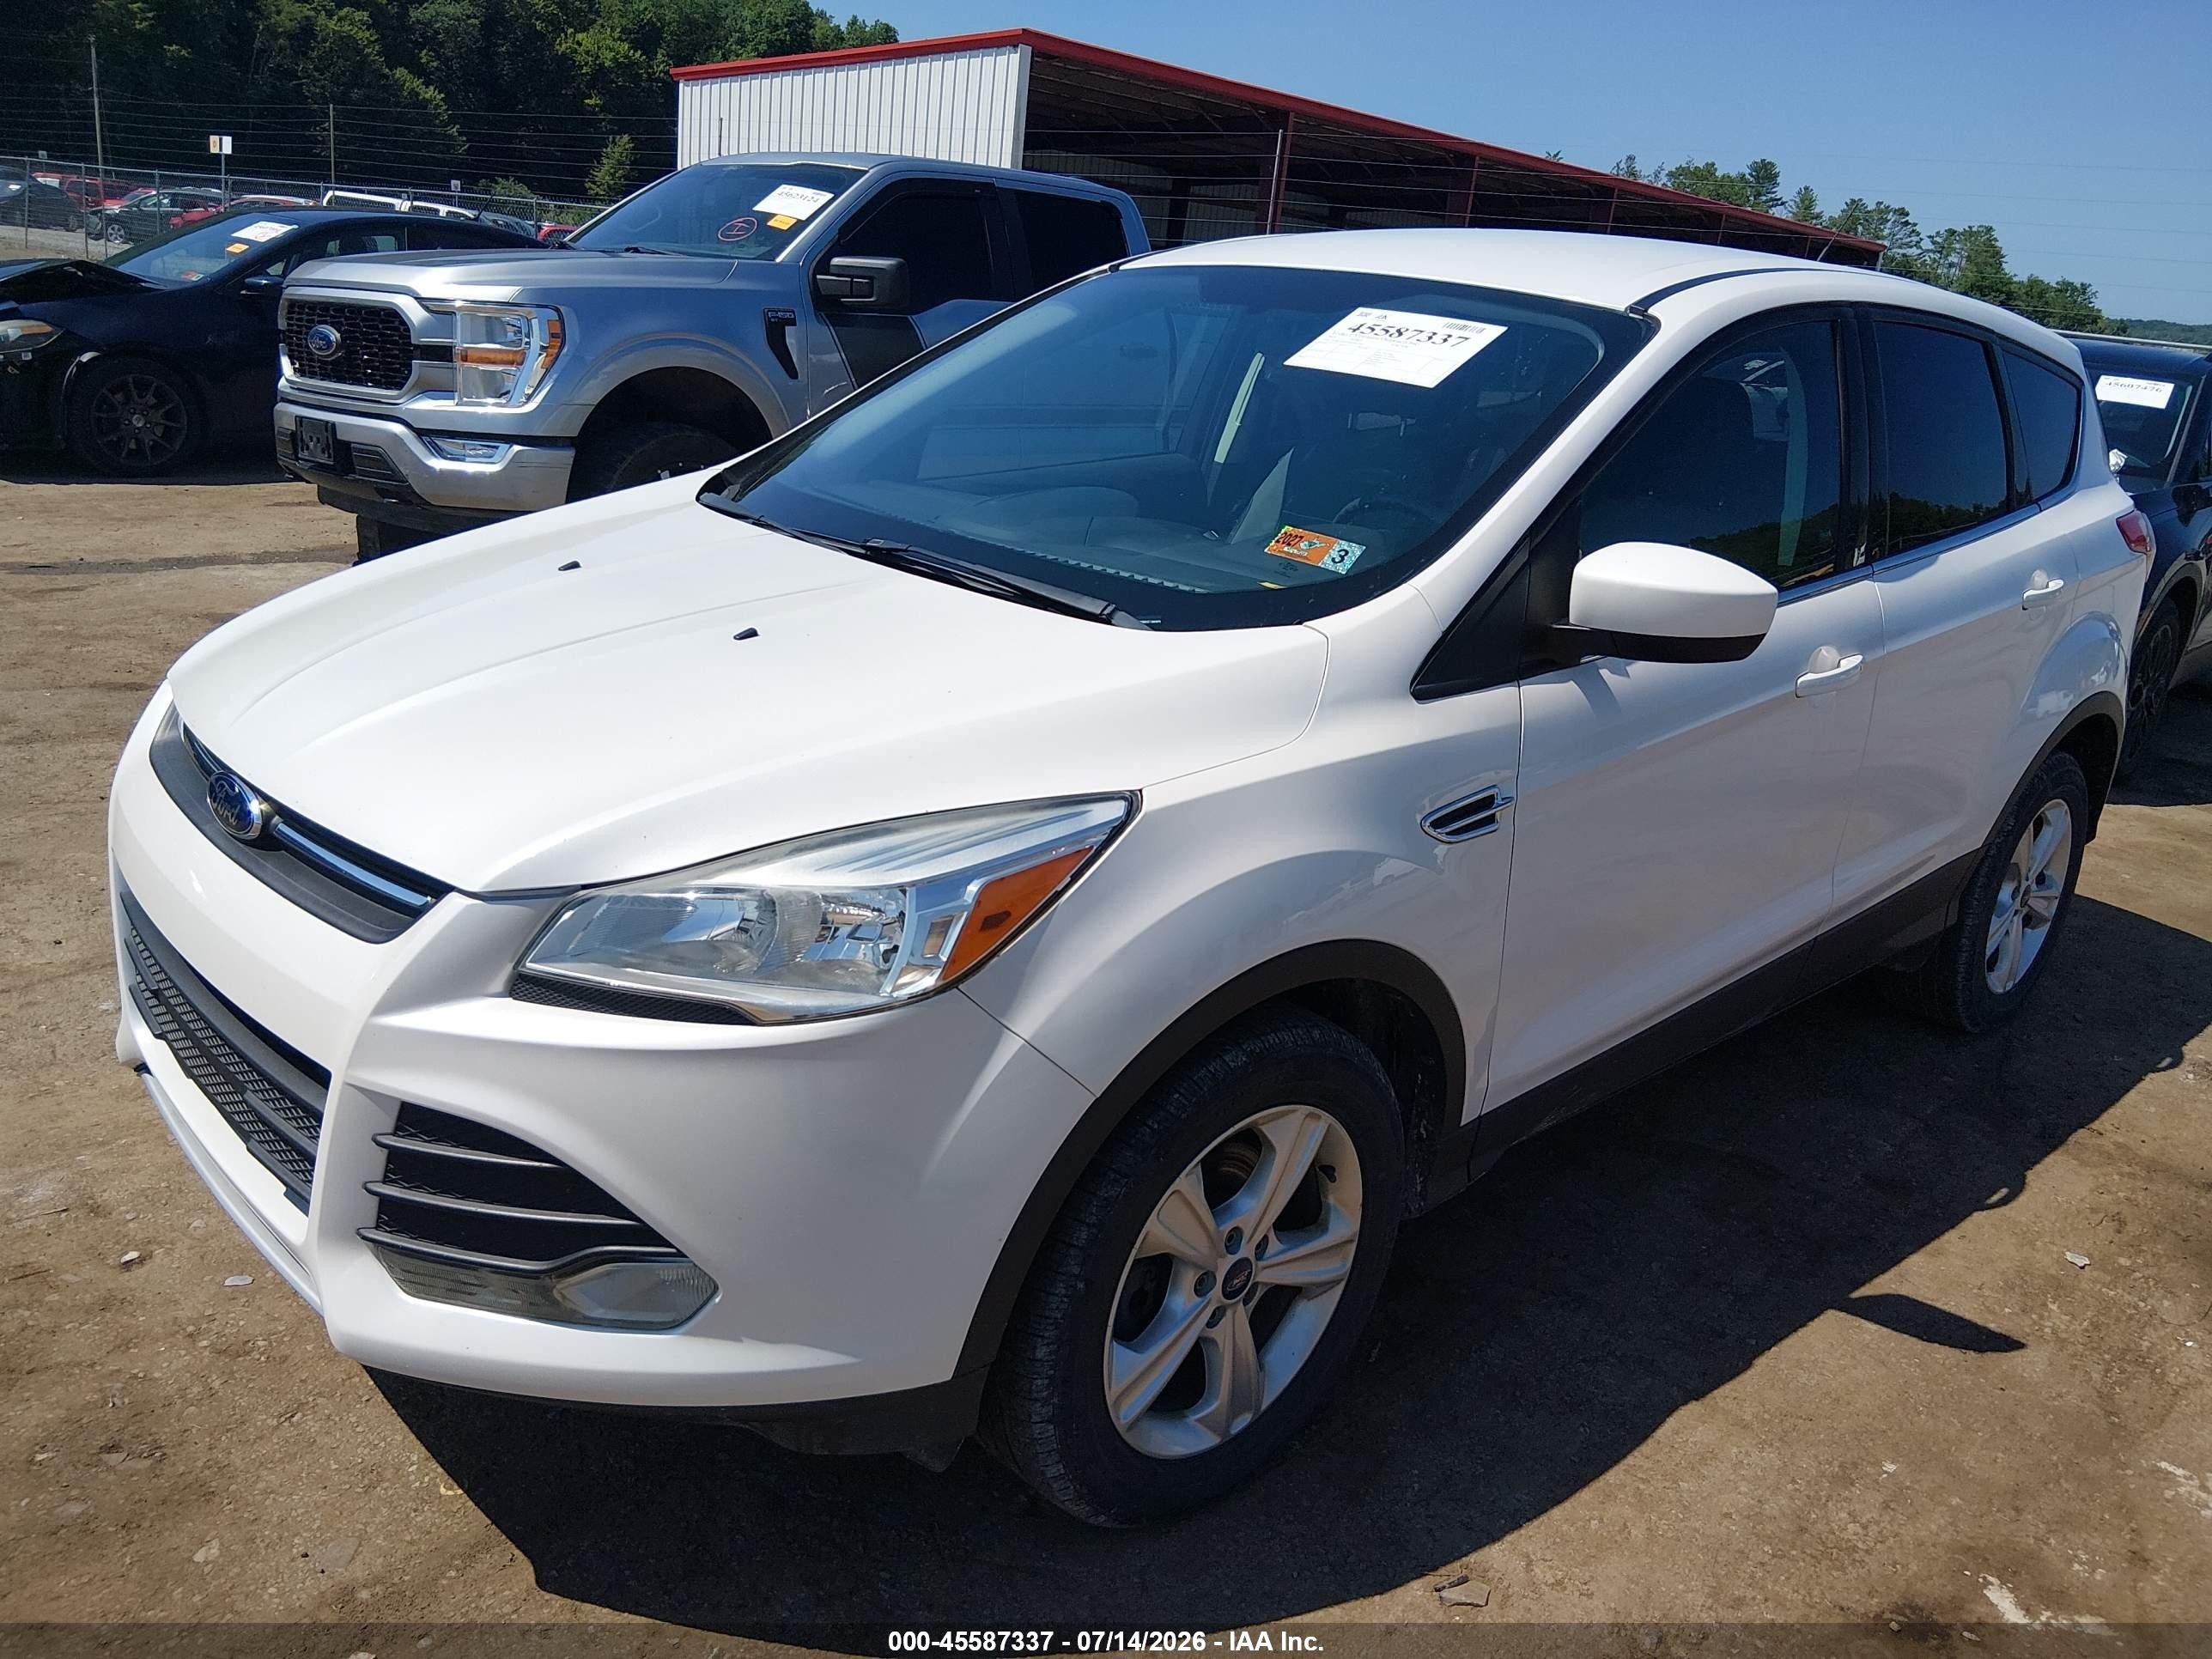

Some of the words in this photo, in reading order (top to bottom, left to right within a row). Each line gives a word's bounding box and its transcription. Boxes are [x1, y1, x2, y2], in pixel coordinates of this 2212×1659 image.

[1347, 322, 1471, 348] 45587337
[1276, 532, 1305, 548] 2027
[1331, 549, 1350, 564] 3
[211, 780, 241, 825] Ford
